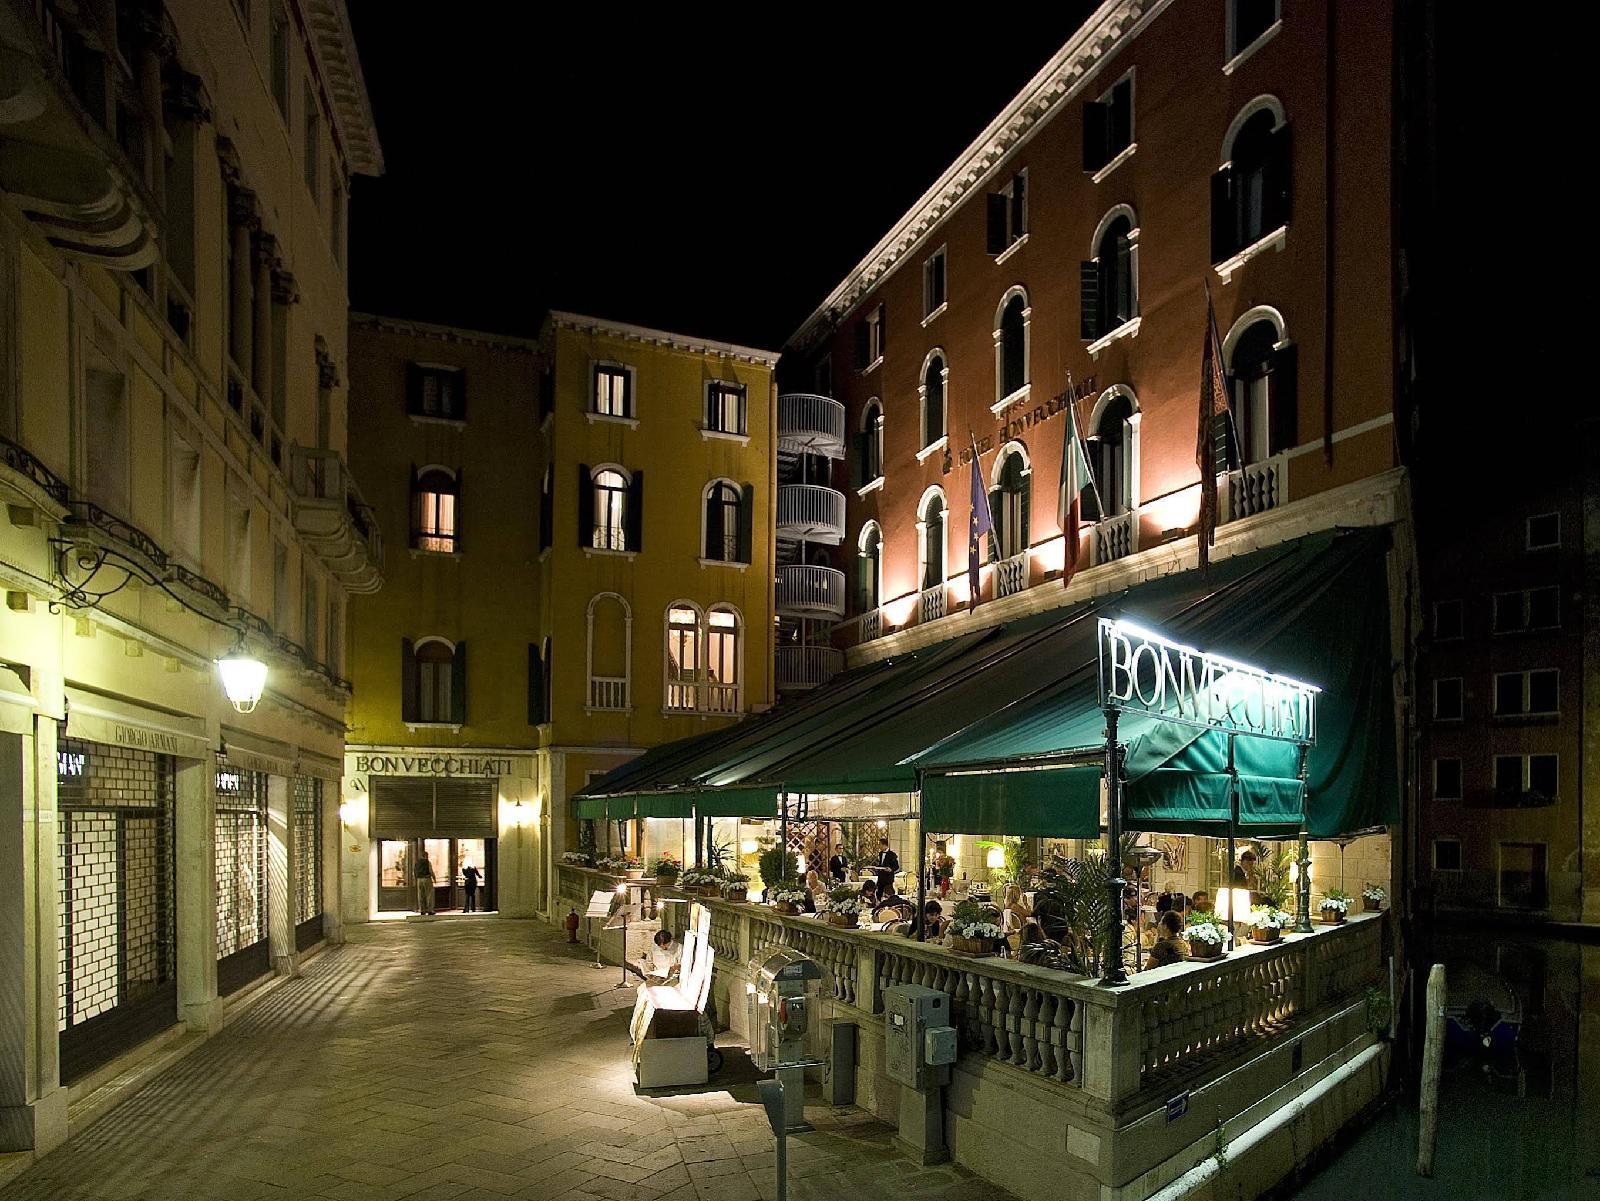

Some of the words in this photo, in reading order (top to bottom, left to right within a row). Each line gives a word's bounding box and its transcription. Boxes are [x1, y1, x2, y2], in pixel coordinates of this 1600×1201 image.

[115, 725, 148, 747] GIORGIO
[151, 732, 178, 753] ARMANI
[356, 756, 512, 775] BONVECCHIATI
